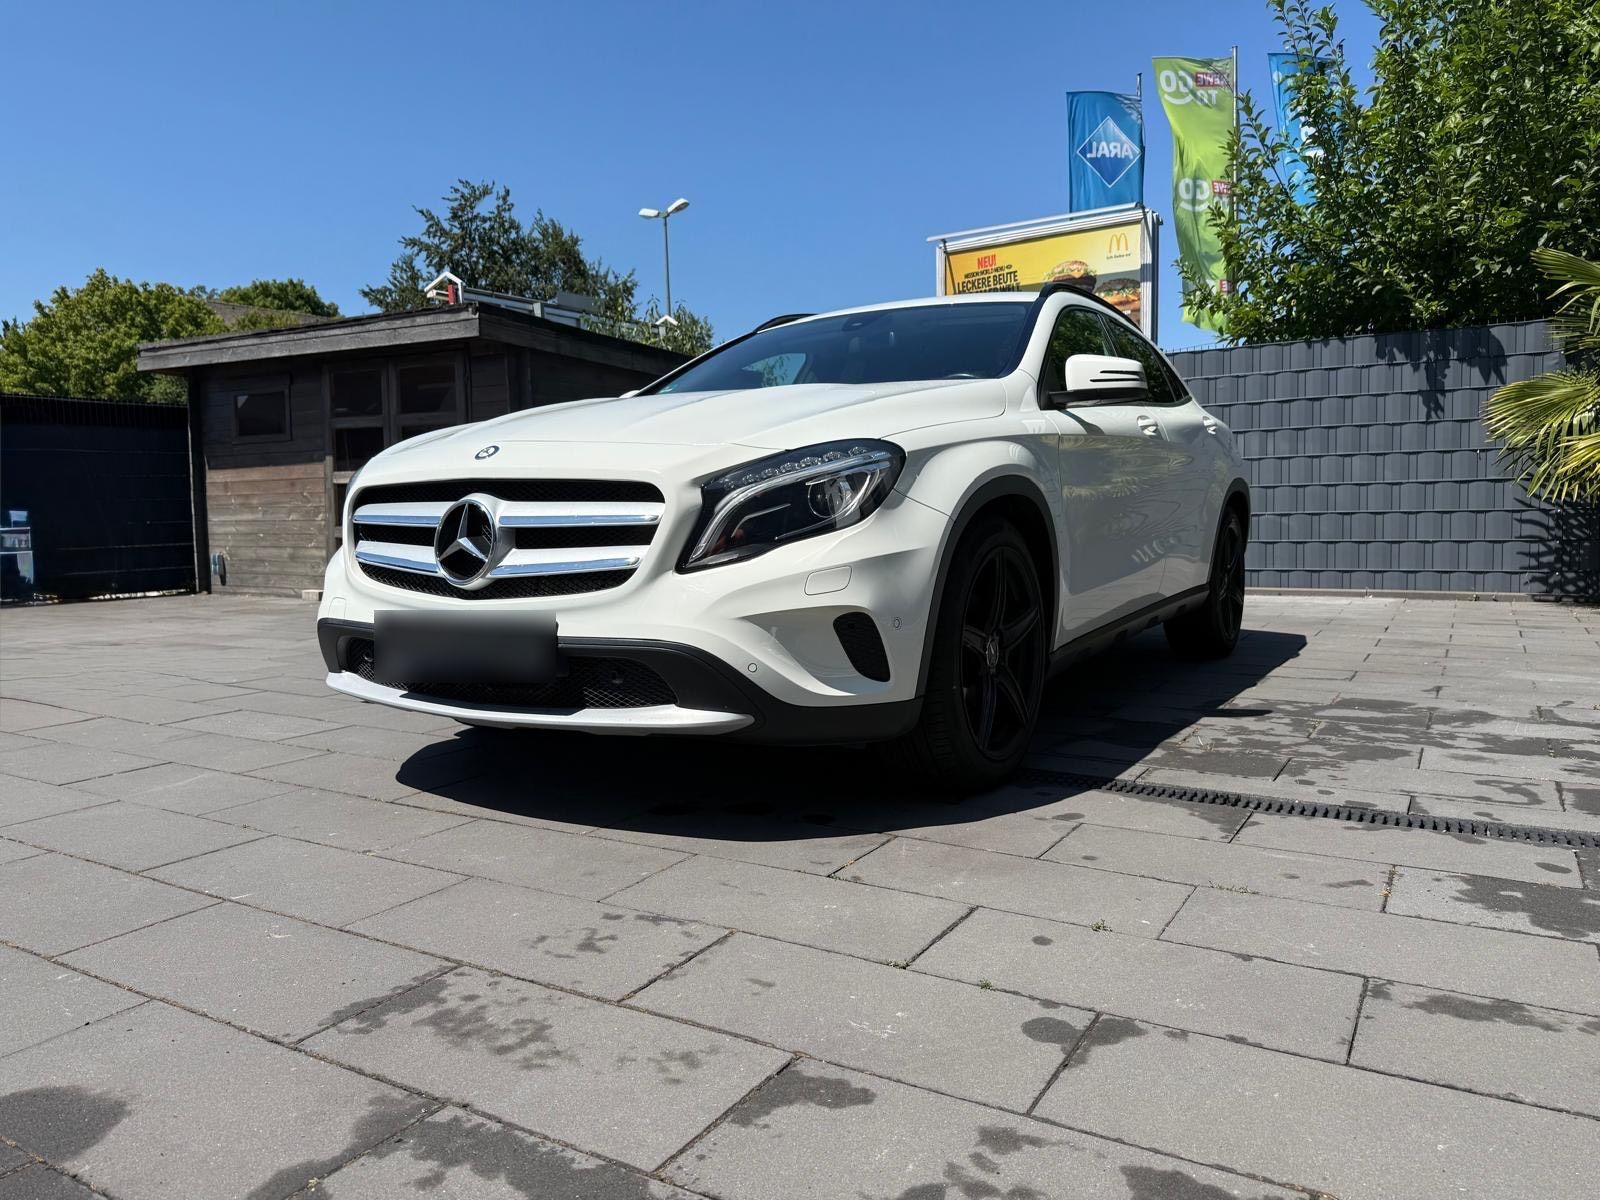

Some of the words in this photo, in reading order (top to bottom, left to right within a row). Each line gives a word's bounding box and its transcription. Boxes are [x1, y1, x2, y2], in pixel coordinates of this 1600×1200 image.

[977, 254, 997, 269] NEU!
[957, 275, 991, 293] LECKERE
[992, 270, 1018, 286] BEUTE
